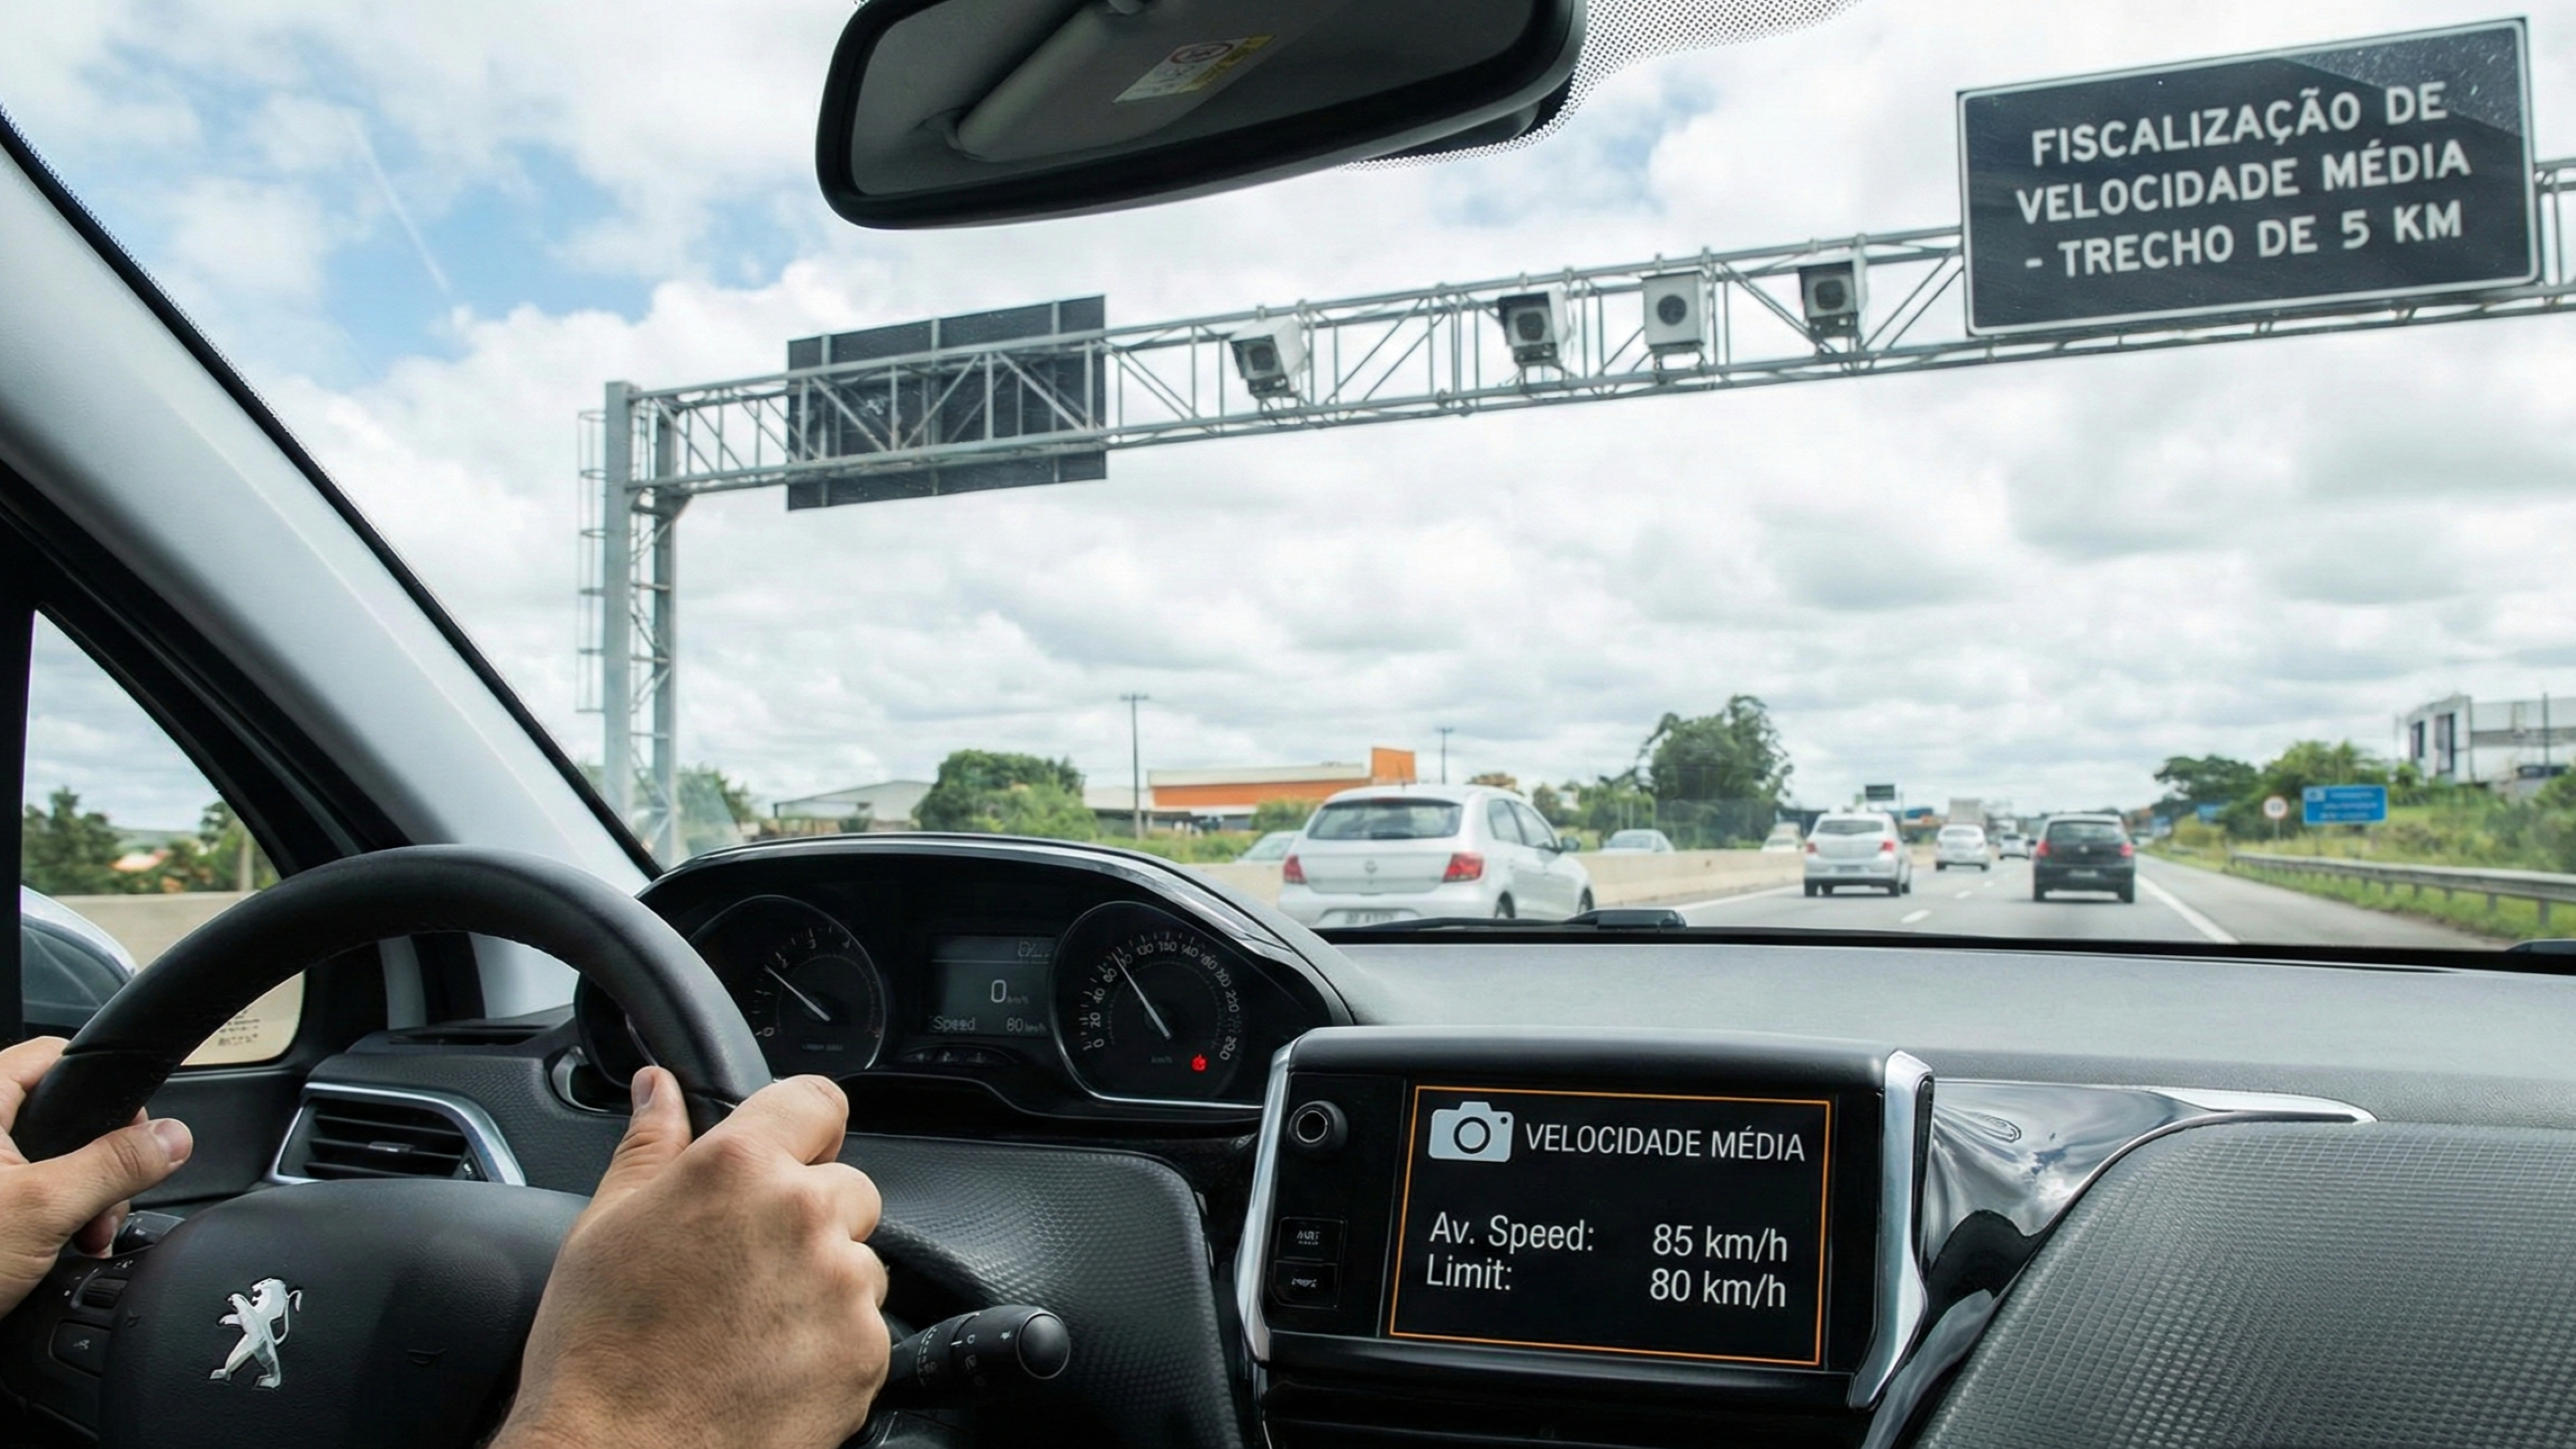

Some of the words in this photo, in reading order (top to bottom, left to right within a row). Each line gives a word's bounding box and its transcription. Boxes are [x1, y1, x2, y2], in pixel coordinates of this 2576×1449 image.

[2032, 88, 2360, 165] FISCALIZAÇÃO
[2386, 81, 2446, 123] DE
[2016, 164, 2299, 224] VELOCIDADE
[2323, 140, 2470, 191] MÉDIA
[2058, 225, 2233, 277] TRECHO
[2258, 216, 2318, 257] DE
[2343, 210, 2369, 249] 5
[2394, 200, 2461, 242] KM
[990, 979, 1007, 1004] 0
[932, 1015, 977, 1033] Speed
[1089, 1012, 1101, 1029] 20
[1092, 1038, 1105, 1048] 0
[1526, 1123, 1701, 1157] VELOCIDADE
[1711, 1123, 1805, 1161] MÉDIA
[1429, 1211, 1475, 1244] Av.
[1487, 1215, 1595, 1255] Speed:
[1653, 1224, 1693, 1257] 85
[1704, 1225, 1787, 1263] km/h
[1426, 1253, 1512, 1291] Limit:
[1649, 1267, 1690, 1301] 80
[1702, 1270, 1785, 1309] km/h
